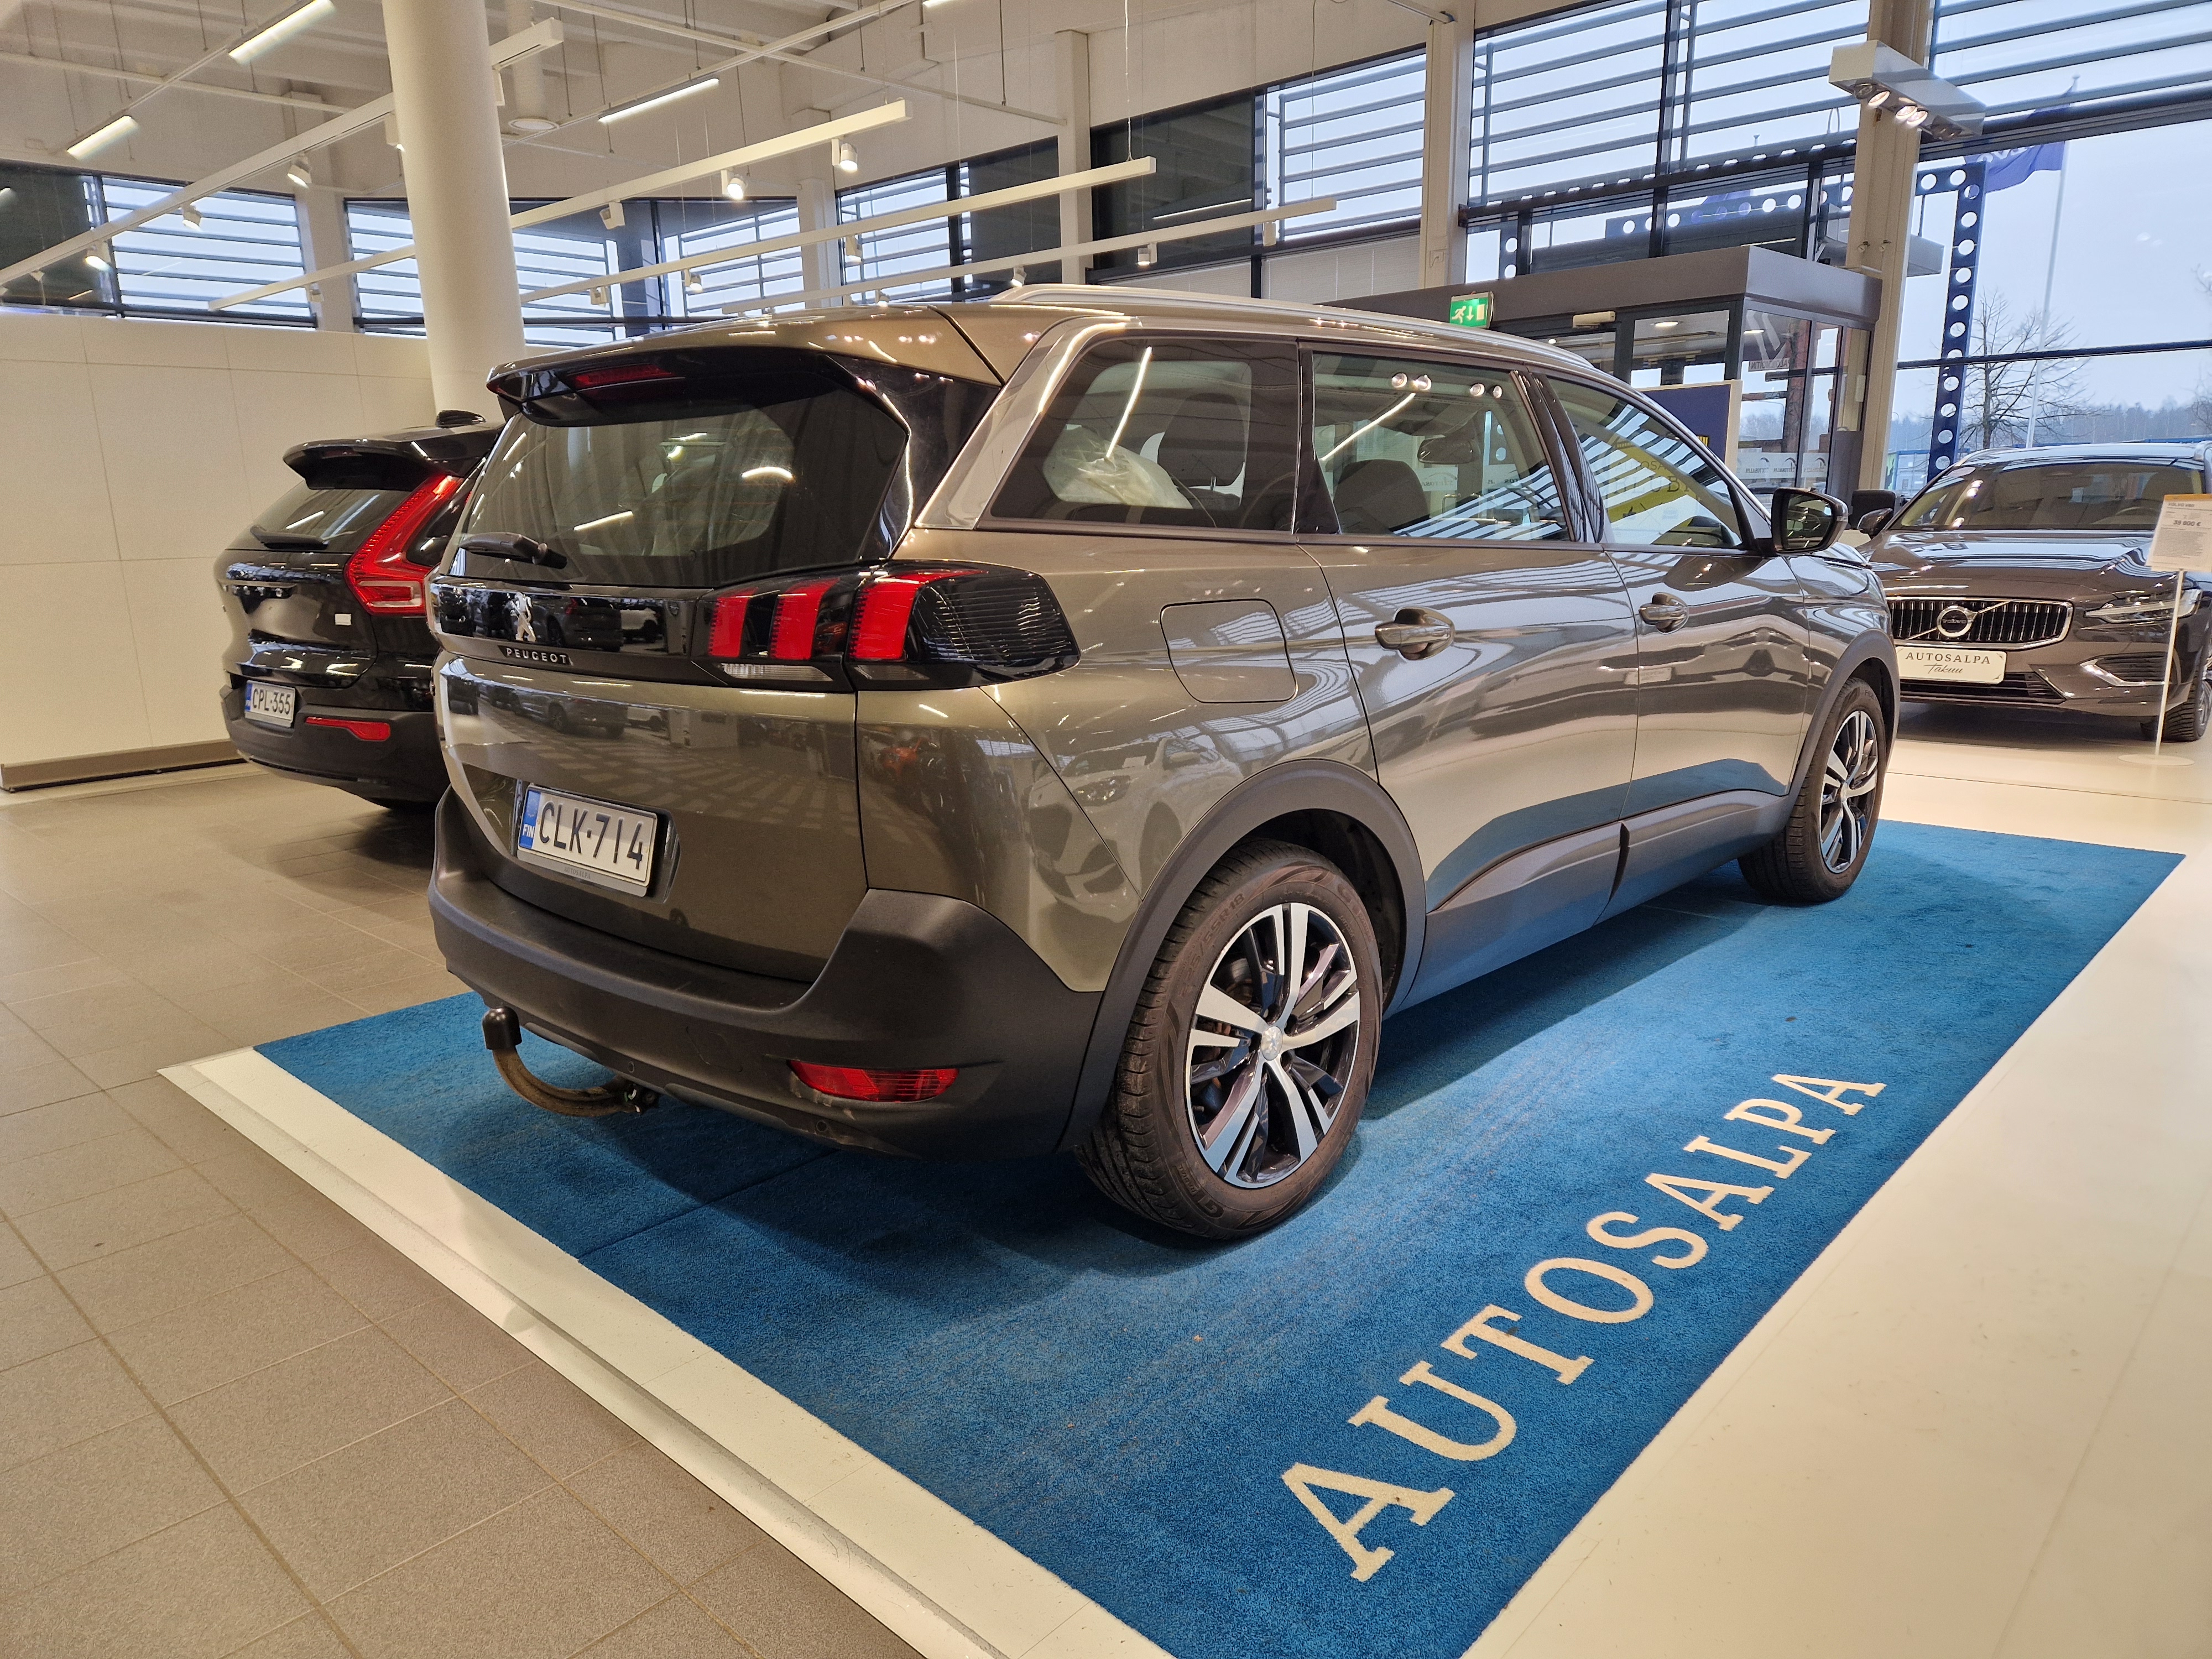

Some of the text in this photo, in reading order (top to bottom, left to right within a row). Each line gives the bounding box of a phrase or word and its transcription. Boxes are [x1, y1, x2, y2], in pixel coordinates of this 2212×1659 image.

[506, 648, 566, 664] PEUGEOT
[1905, 652, 1991, 664] AUTOSALPA
[1923, 663, 1963, 674] Takuu
[252, 687, 291, 715] CPL-355
[522, 801, 644, 870] FIN CLK-714
[564, 866, 591, 879] AUTOSALPA
[1281, 1073, 1887, 1582] AUTOSALPA
